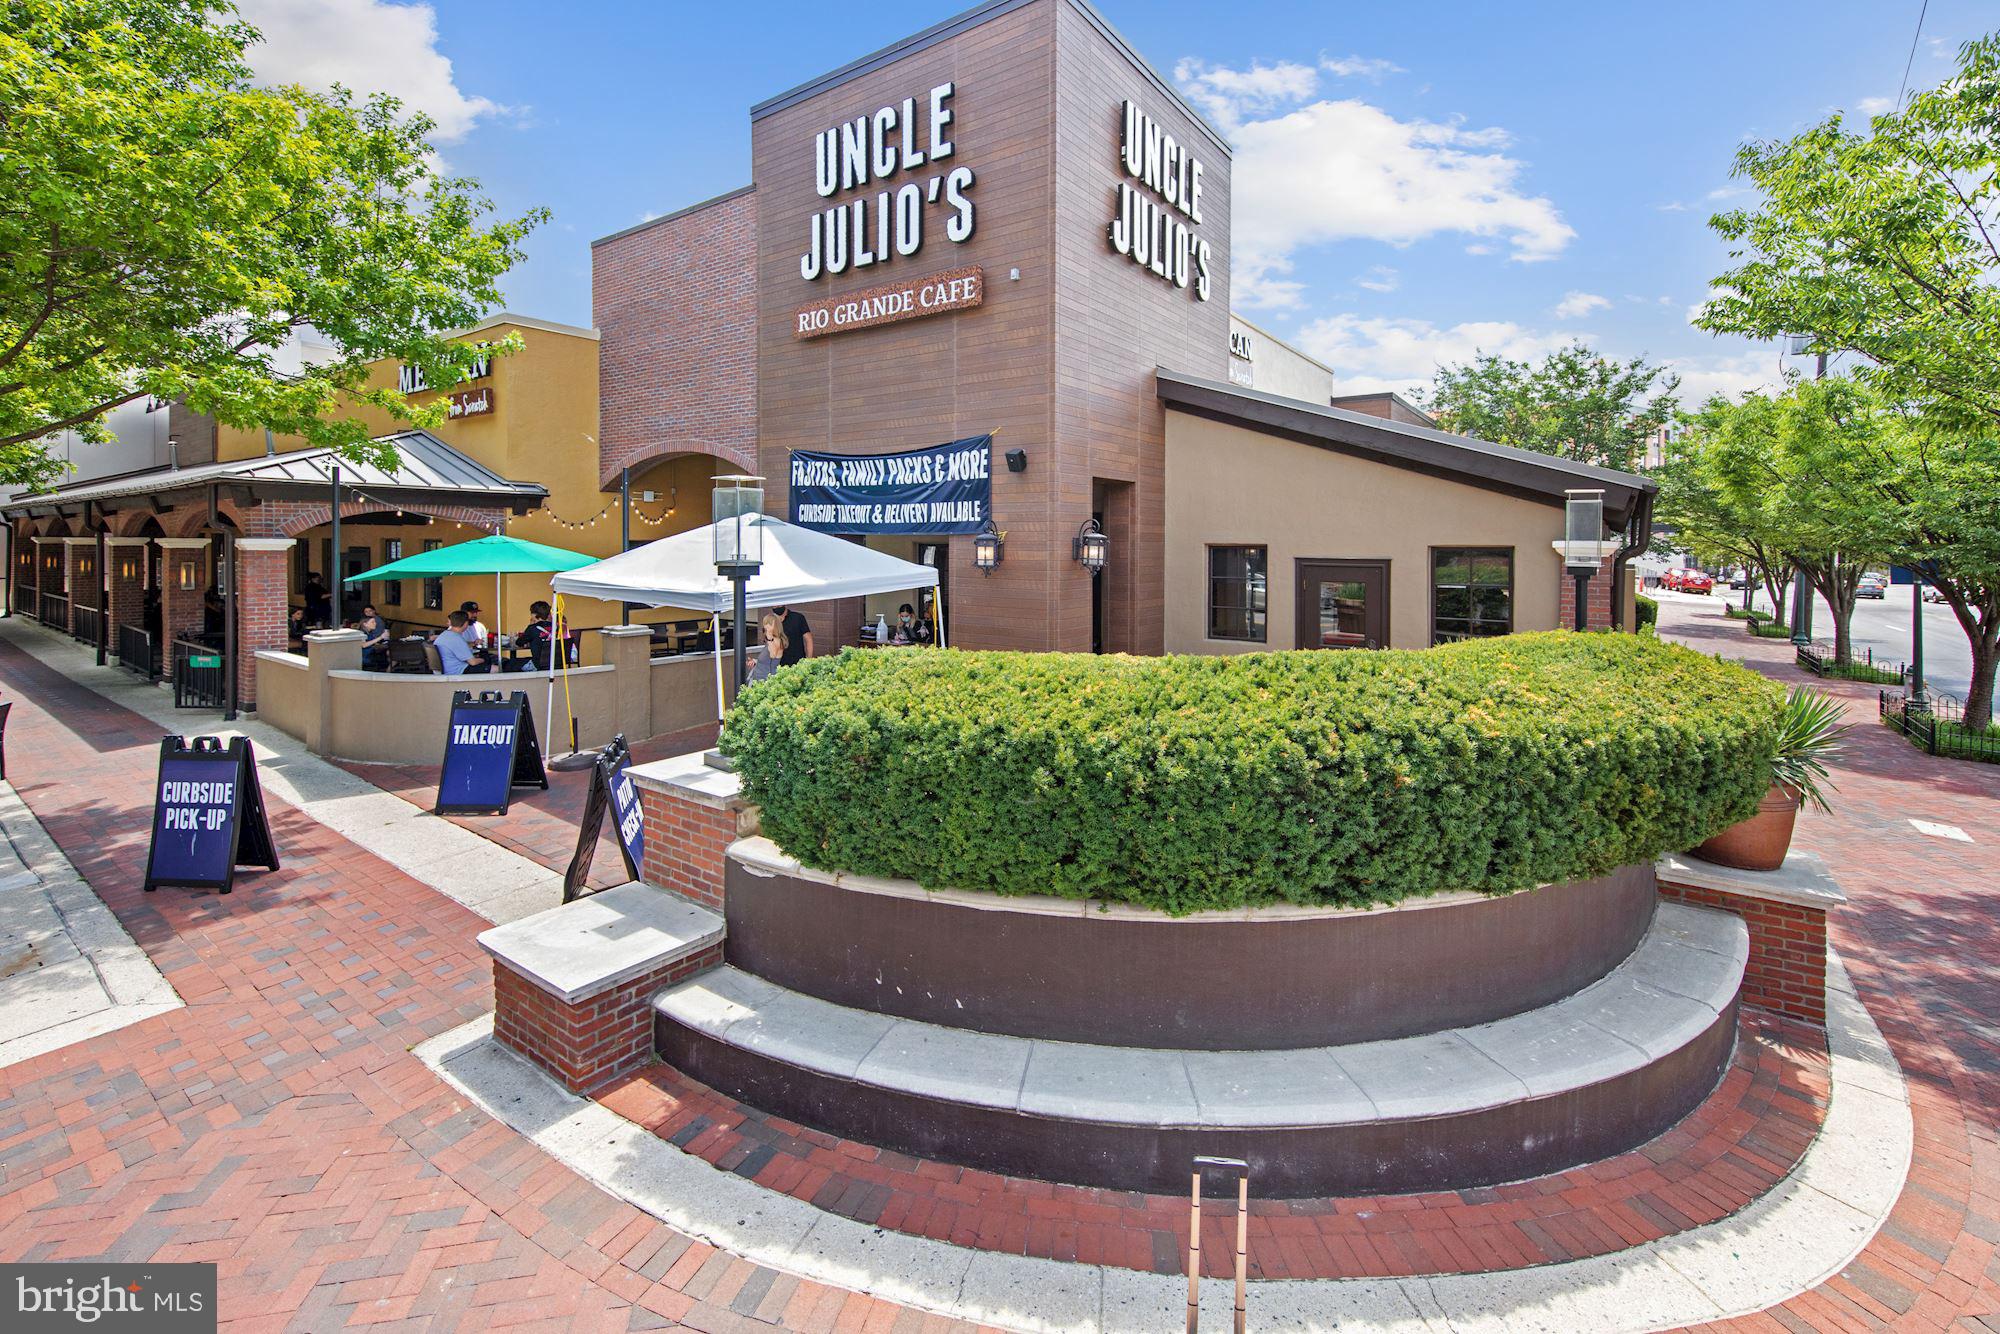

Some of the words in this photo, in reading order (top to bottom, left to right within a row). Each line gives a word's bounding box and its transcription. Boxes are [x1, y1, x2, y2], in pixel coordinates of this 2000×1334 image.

[816, 82, 954, 197] UNCLE
[1121, 99, 1203, 225] UNCLE
[801, 166, 976, 281] JULIO'S
[1108, 182, 1211, 302] JULIO'S
[798, 309, 829, 332] RIO
[834, 290, 914, 325] GRANDE
[920, 276, 976, 308] CAFE
[791, 460, 840, 490] FAJITAS,
[841, 458, 886, 487] FAMILY
[886, 455, 933, 486] PACKS
[935, 453, 945, 483] &
[947, 448, 989, 482] MORE
[798, 503, 836, 523] CURBSIDE
[837, 504, 872, 524] TAKEOUT
[872, 503, 883, 524] &
[884, 502, 929, 524] DELIVERY
[930, 500, 982, 523] AVAILABLE
[453, 724, 514, 745] TAKEOUT
[162, 781, 233, 804] CURBSIDE
[165, 807, 227, 831] PICK-UP
